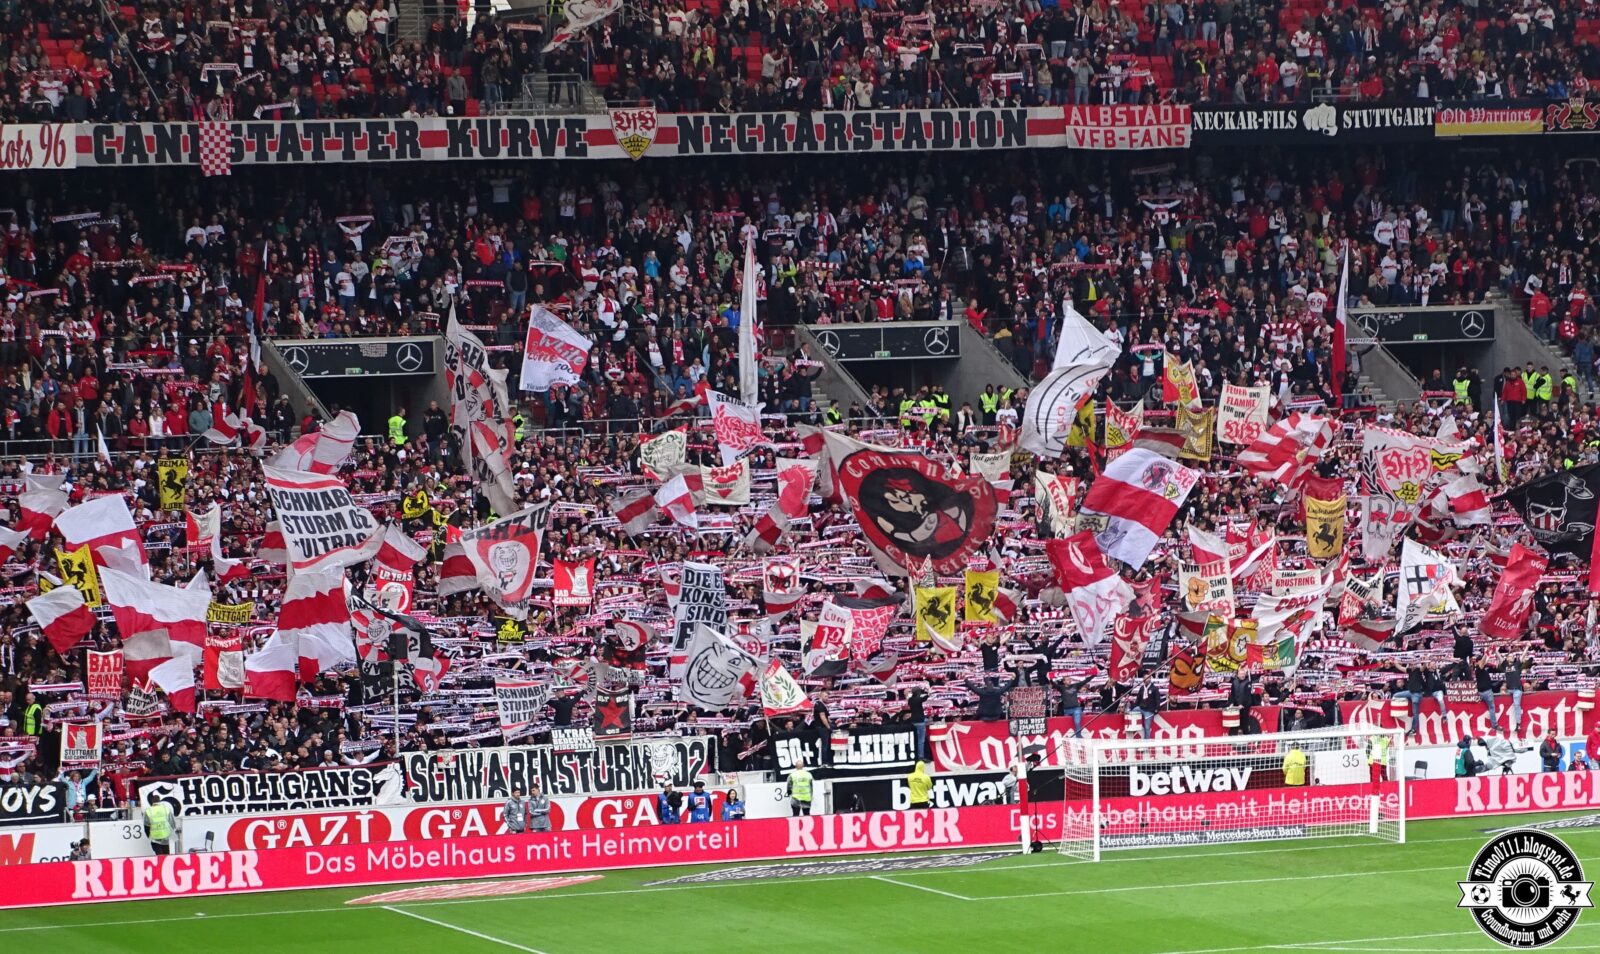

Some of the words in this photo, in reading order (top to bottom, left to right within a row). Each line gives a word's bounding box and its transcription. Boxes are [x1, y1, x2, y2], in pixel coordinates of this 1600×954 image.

[1069, 104, 1191, 126] ALBSTADT
[1193, 109, 1298, 131] NECKAR-FILS
[1342, 107, 1435, 129] STUTTGART
[1440, 107, 1467, 124] Old
[1470, 106, 1532, 124] Warriors
[446, 118, 588, 158] KURVE
[676, 109, 1028, 154] NECKARSTADION
[1073, 127, 1185, 148] VFB-FANS
[39, 123, 67, 167] 96
[1226, 386, 1247, 396] FEUER
[1226, 396, 1257, 408] FLAMME
[281, 511, 349, 535] STURM
[683, 569, 712, 589] DIE
[1201, 562, 1227, 578] ALLE
[1209, 577, 1227, 587] SIND
[1211, 589, 1226, 599] DER
[206, 609, 251, 622] STUTTGART
[686, 606, 726, 624] SIND
[88, 653, 123, 673] BAD
[88, 675, 122, 688] CANN
[502, 698, 538, 712] STURM
[551, 728, 593, 739] ULTRAS
[1341, 753, 1360, 768] 35
[179, 769, 373, 804] HOOLIGANS
[1128, 766, 1254, 797] betway
[122, 824, 142, 839] 33
[786, 808, 963, 852] RIEGER
[1010, 808, 1057, 832] Das
[1068, 798, 1206, 827] Möbelhaus
[1216, 795, 1259, 818] mit
[1101, 833, 1173, 846] Mercedes-Benz
[1174, 832, 1199, 842] Bank
[1206, 828, 1276, 842] Mercedes-Benz
[1277, 825, 1303, 838] Bank
[72, 851, 263, 899] RIEGER
[305, 852, 356, 875] Das
[367, 844, 516, 871] Möbelhaus
[526, 836, 572, 861] mit
[582, 825, 738, 857] Heimvorteil
